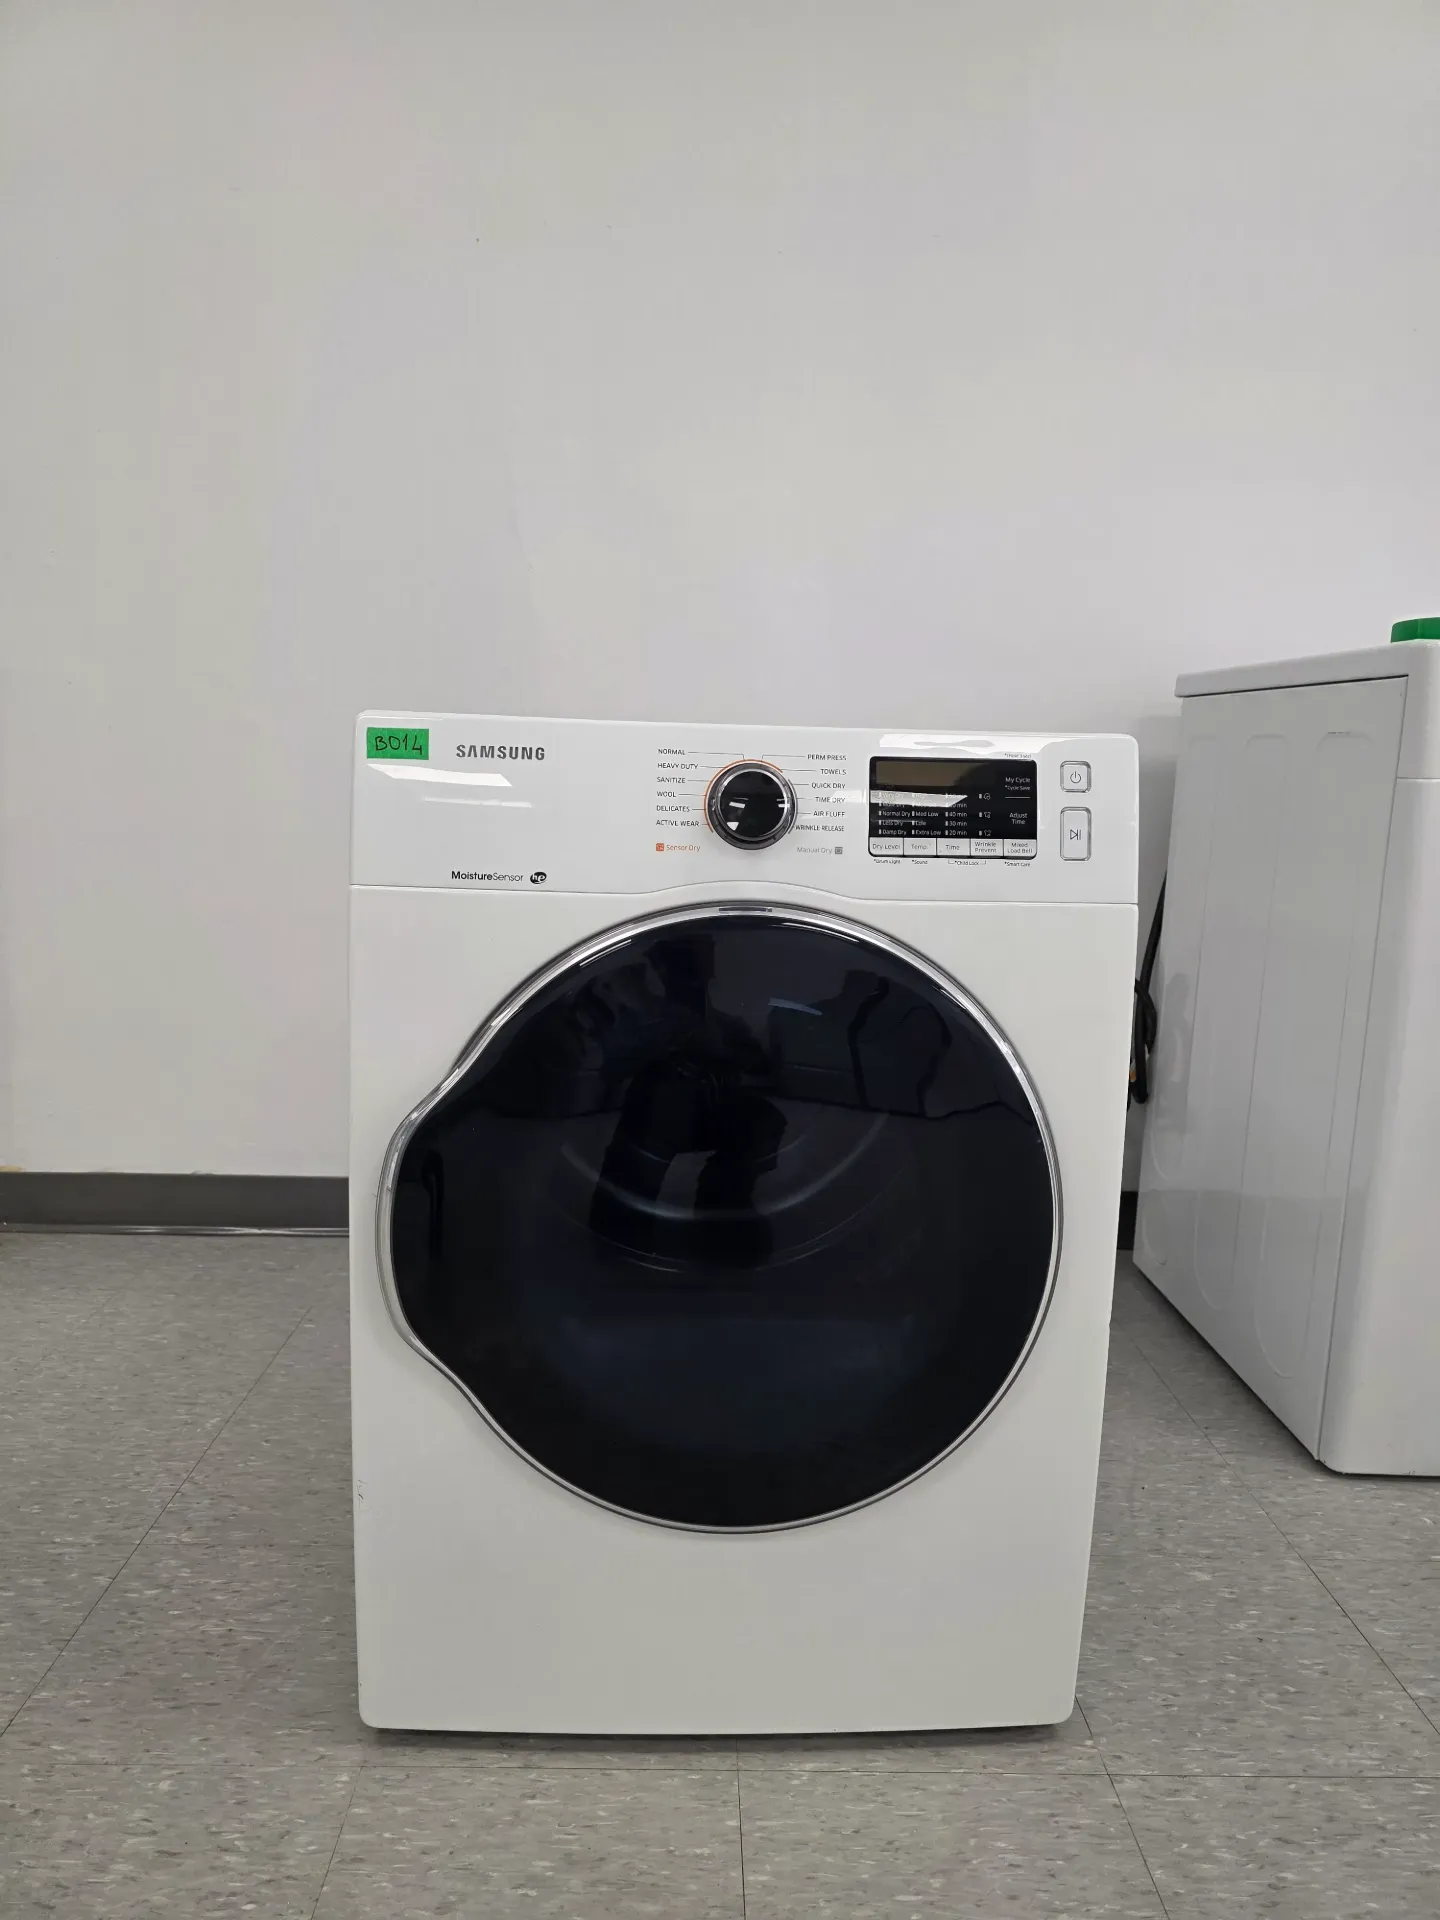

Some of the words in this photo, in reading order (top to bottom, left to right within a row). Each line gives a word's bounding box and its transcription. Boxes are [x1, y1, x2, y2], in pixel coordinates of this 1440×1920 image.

[456, 744, 545, 761] SAMSUNG
[657, 748, 686, 756] NORMAL
[820, 768, 847, 776] TOWELS
[656, 776, 686, 784] SANITIZE
[656, 804, 691, 812] DELICATES
[901, 810, 911, 818] Dry
[655, 819, 679, 827] ACTIVE
[688, 844, 701, 852] Dry
[820, 847, 833, 855] Dry
[872, 843, 883, 851] Dry
[451, 870, 524, 882] MoistureSensor
